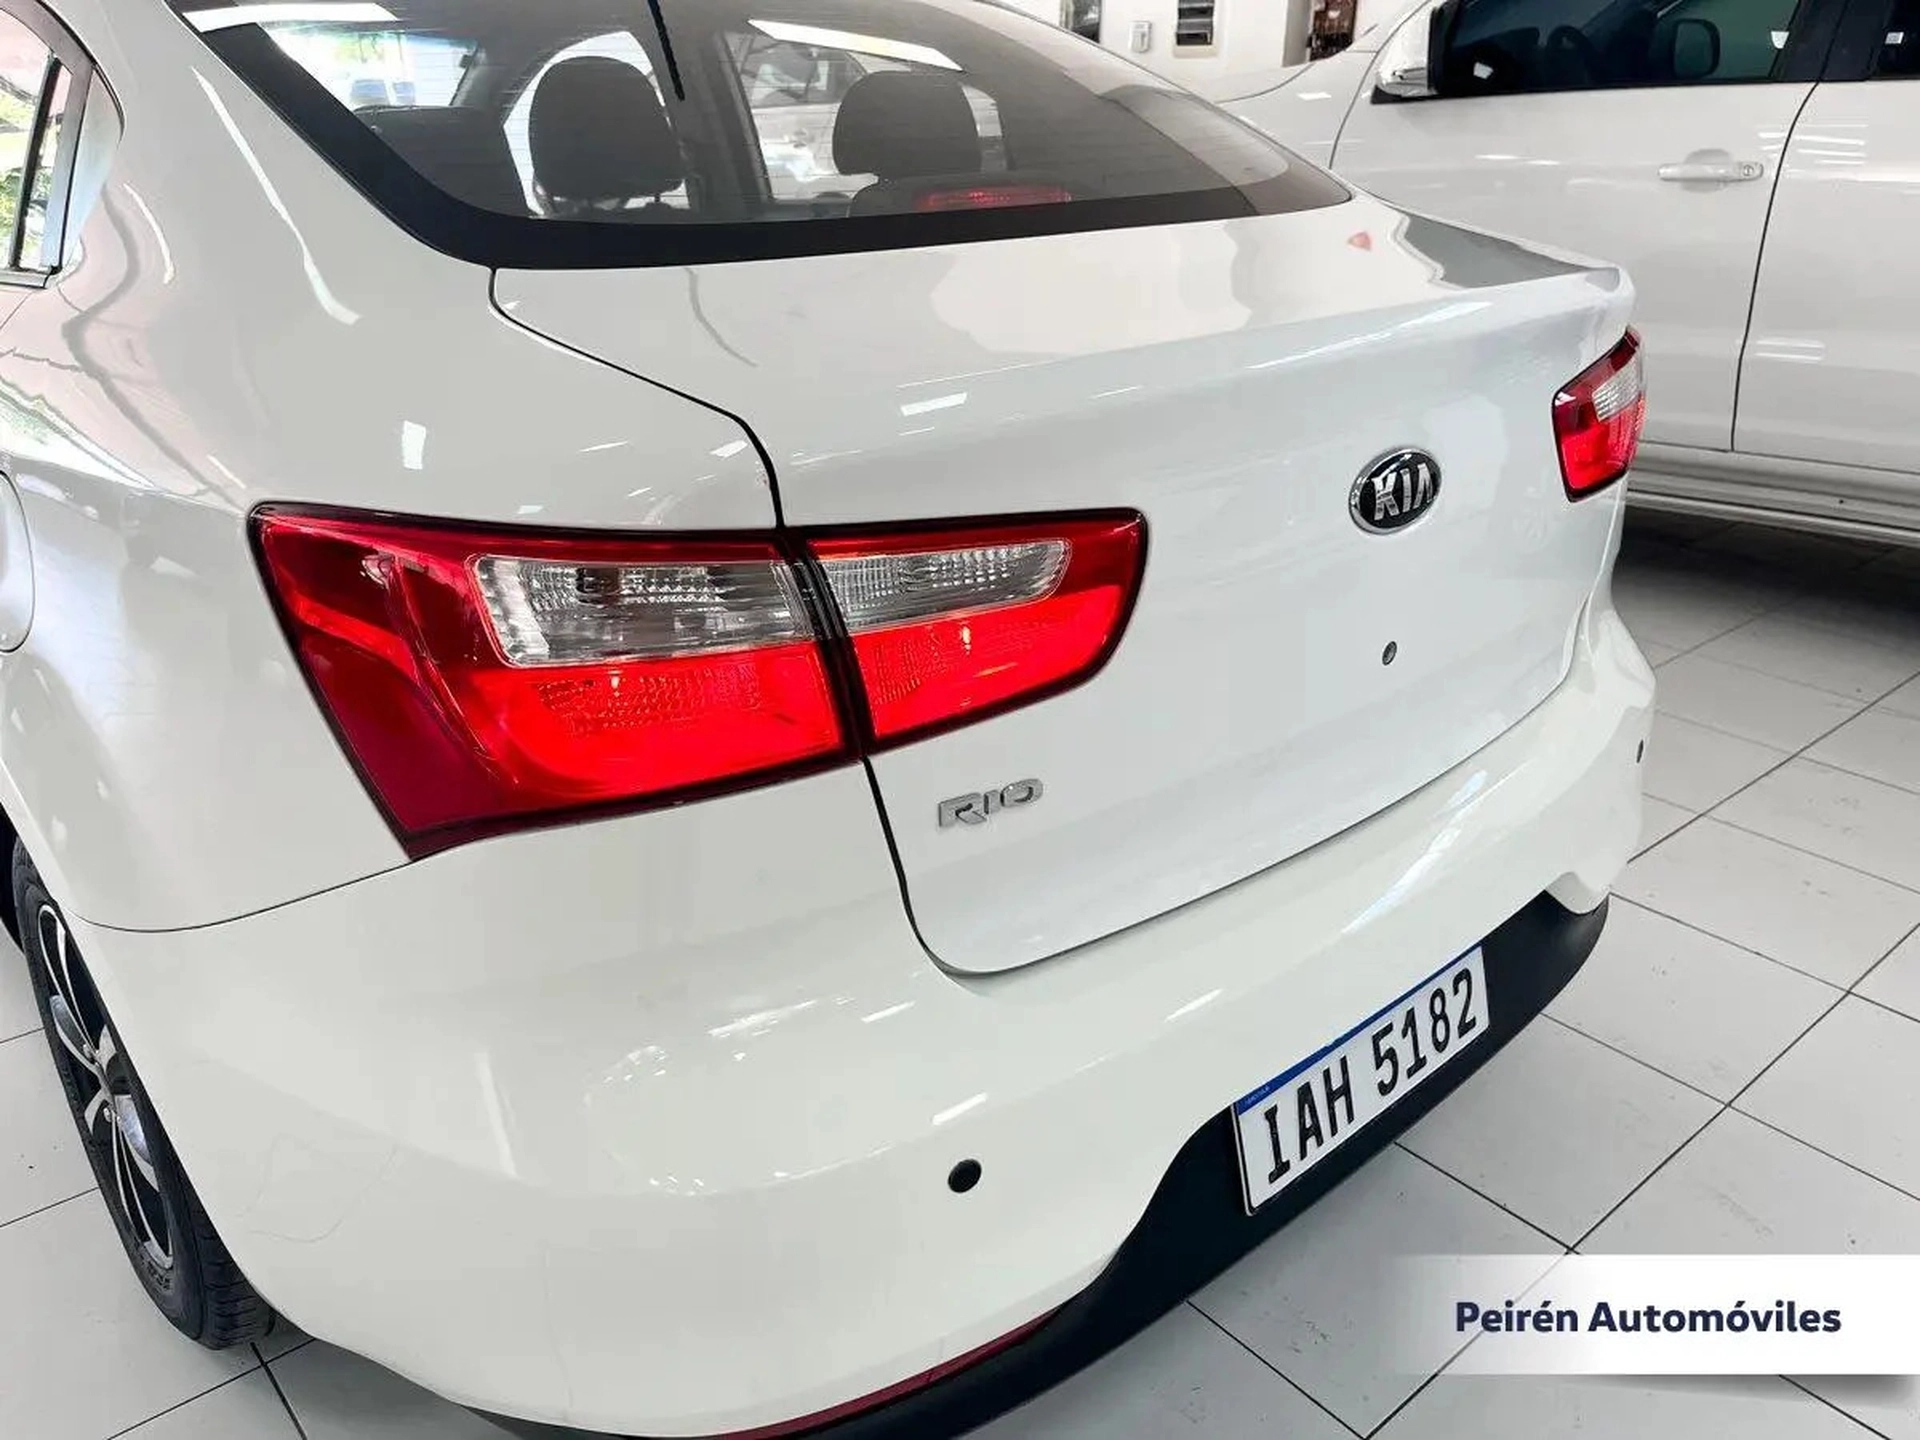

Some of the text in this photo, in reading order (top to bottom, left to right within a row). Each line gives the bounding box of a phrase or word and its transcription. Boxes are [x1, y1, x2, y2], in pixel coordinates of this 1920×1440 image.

[1371, 463, 1433, 520] KIA
[938, 778, 1043, 827] RIO
[1264, 968, 1476, 1184] IAH 5182
